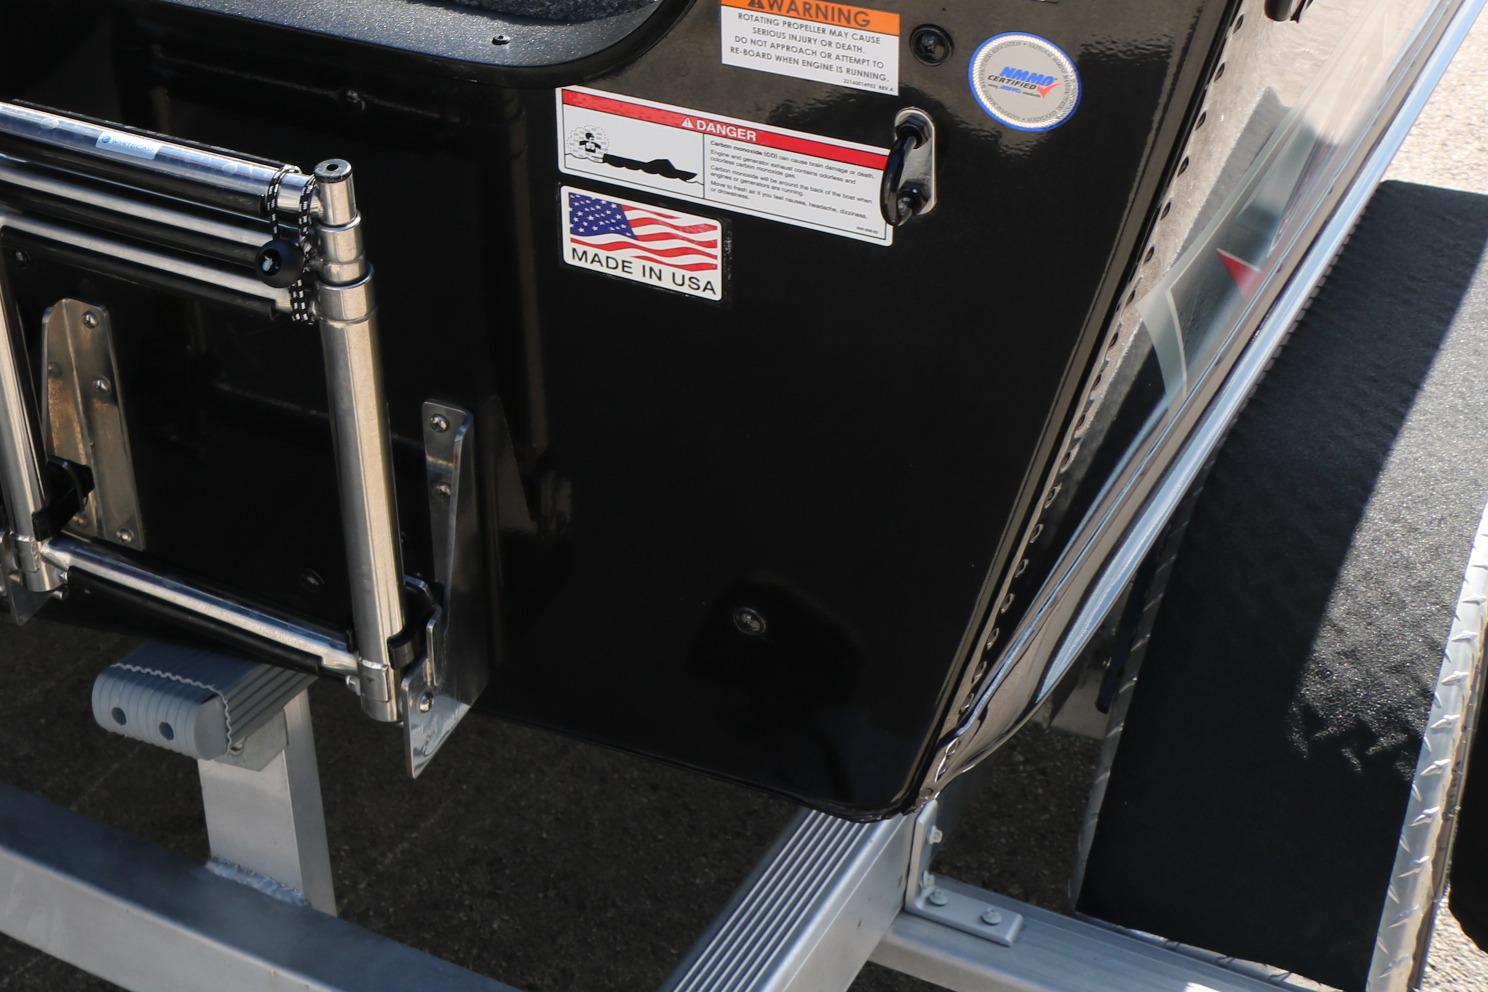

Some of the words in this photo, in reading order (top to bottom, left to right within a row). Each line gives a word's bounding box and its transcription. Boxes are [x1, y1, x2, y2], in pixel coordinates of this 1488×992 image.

[738, 12, 780, 27] ROTATING
[782, 20, 826, 35] PROPELLER
[829, 29, 849, 39] MAY
[851, 33, 881, 45] CAUSE
[752, 26, 786, 40] SERIOUS
[788, 33, 817, 45] INJURY
[820, 39, 833, 48] OR
[835, 42, 864, 54] DEATH.
[730, 46, 772, 61] RE-BOARD
[774, 55, 799, 66] WHEN
[802, 60, 834, 72] ENGINE
[836, 66, 843, 74] IS
[846, 67, 889, 82] RUNNING.
[734, 35, 748, 44] DO
[750, 38, 767, 48] NOT
[769, 42, 817, 57] APPROACH
[819, 51, 832, 60] OR
[834, 54, 871, 67] ATTEMPT
[872, 60, 884, 69] TO
[987, 74, 1037, 90] CERTIFIED
[696, 119, 757, 142] DANGER
[733, 145, 763, 156] monoxide
[571, 247, 634, 274] MADE
[642, 265, 662, 282] IN
[672, 272, 717, 295] USA
